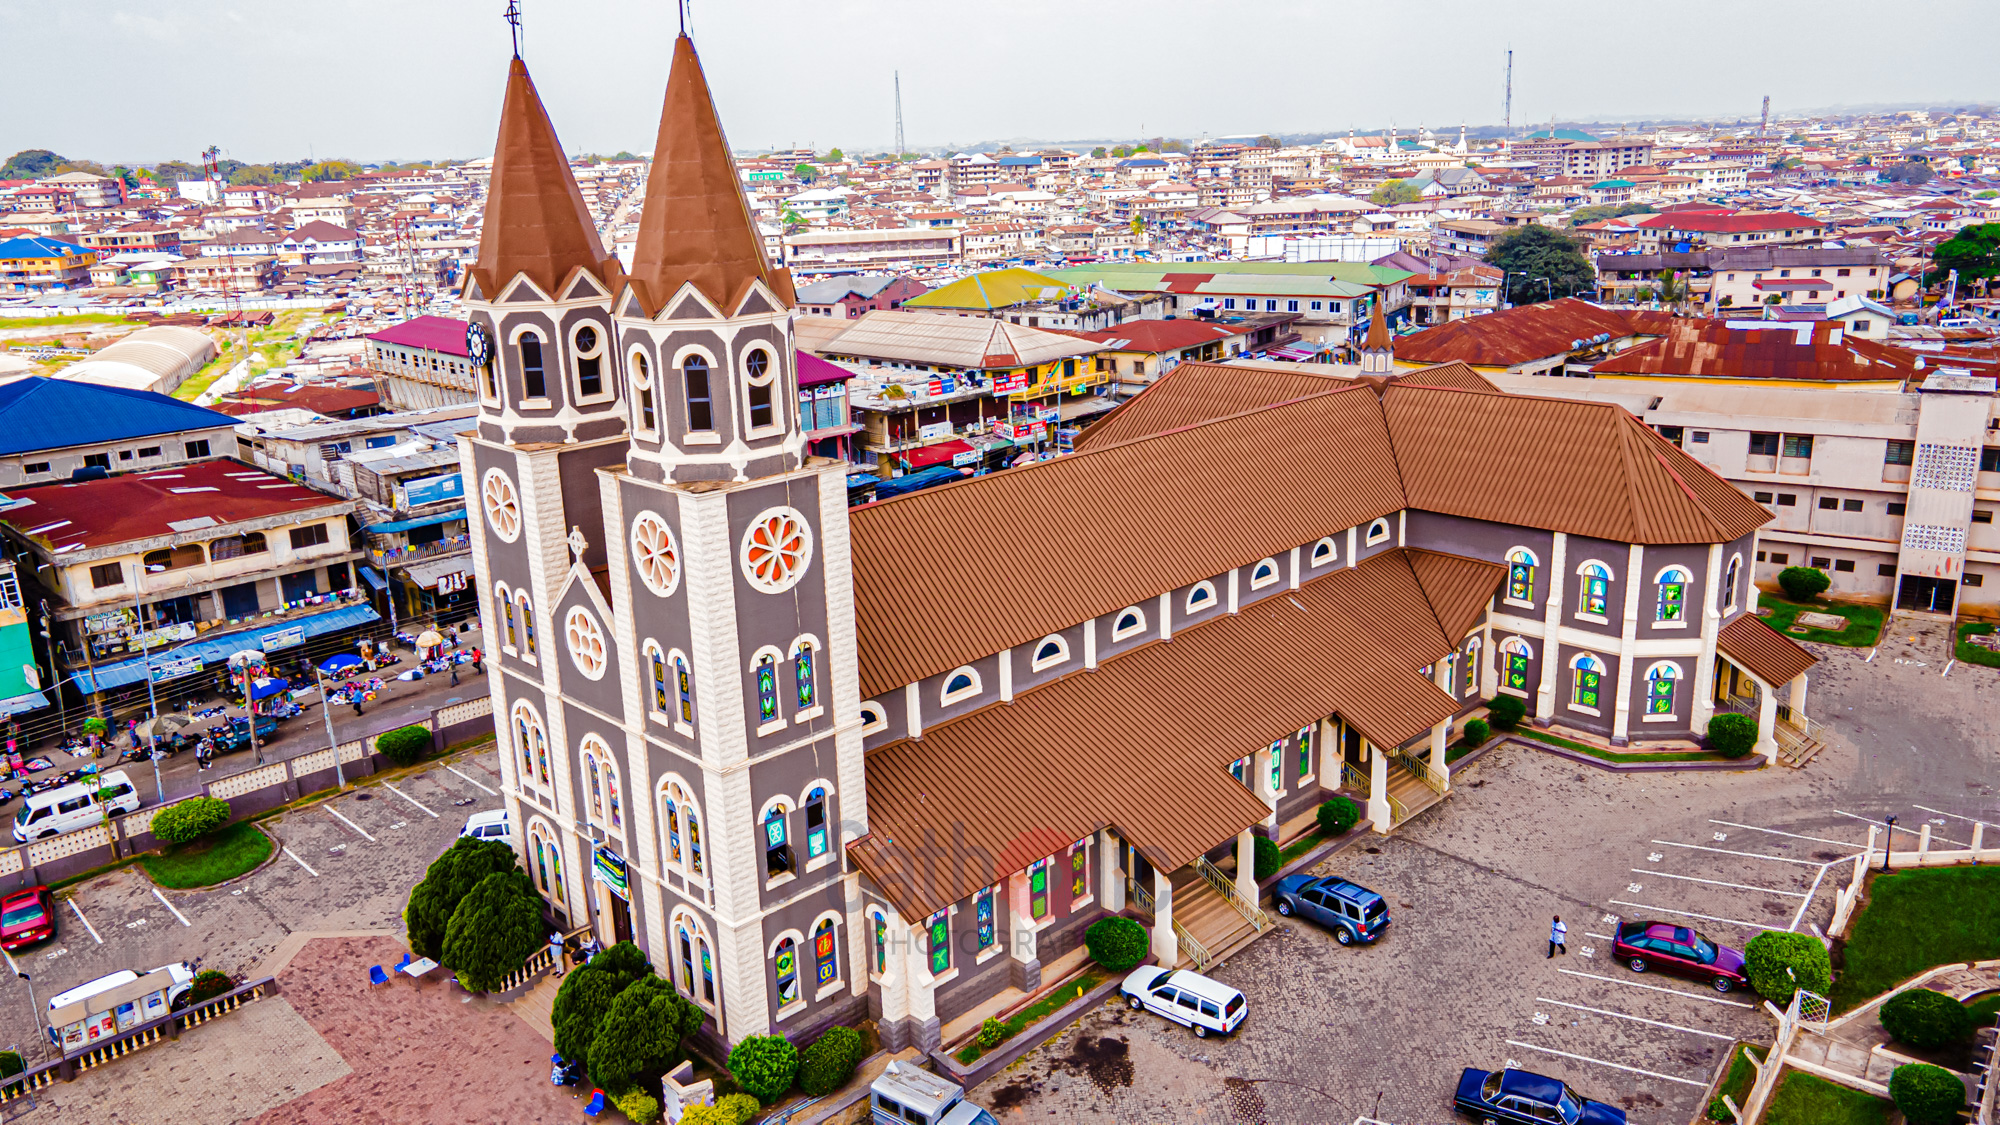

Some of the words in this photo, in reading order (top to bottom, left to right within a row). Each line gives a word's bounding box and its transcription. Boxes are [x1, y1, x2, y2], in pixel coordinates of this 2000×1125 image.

[1602, 913, 1620, 925] 32
[1578, 945, 1596, 958] 31
[1531, 1011, 1551, 1026] 30
